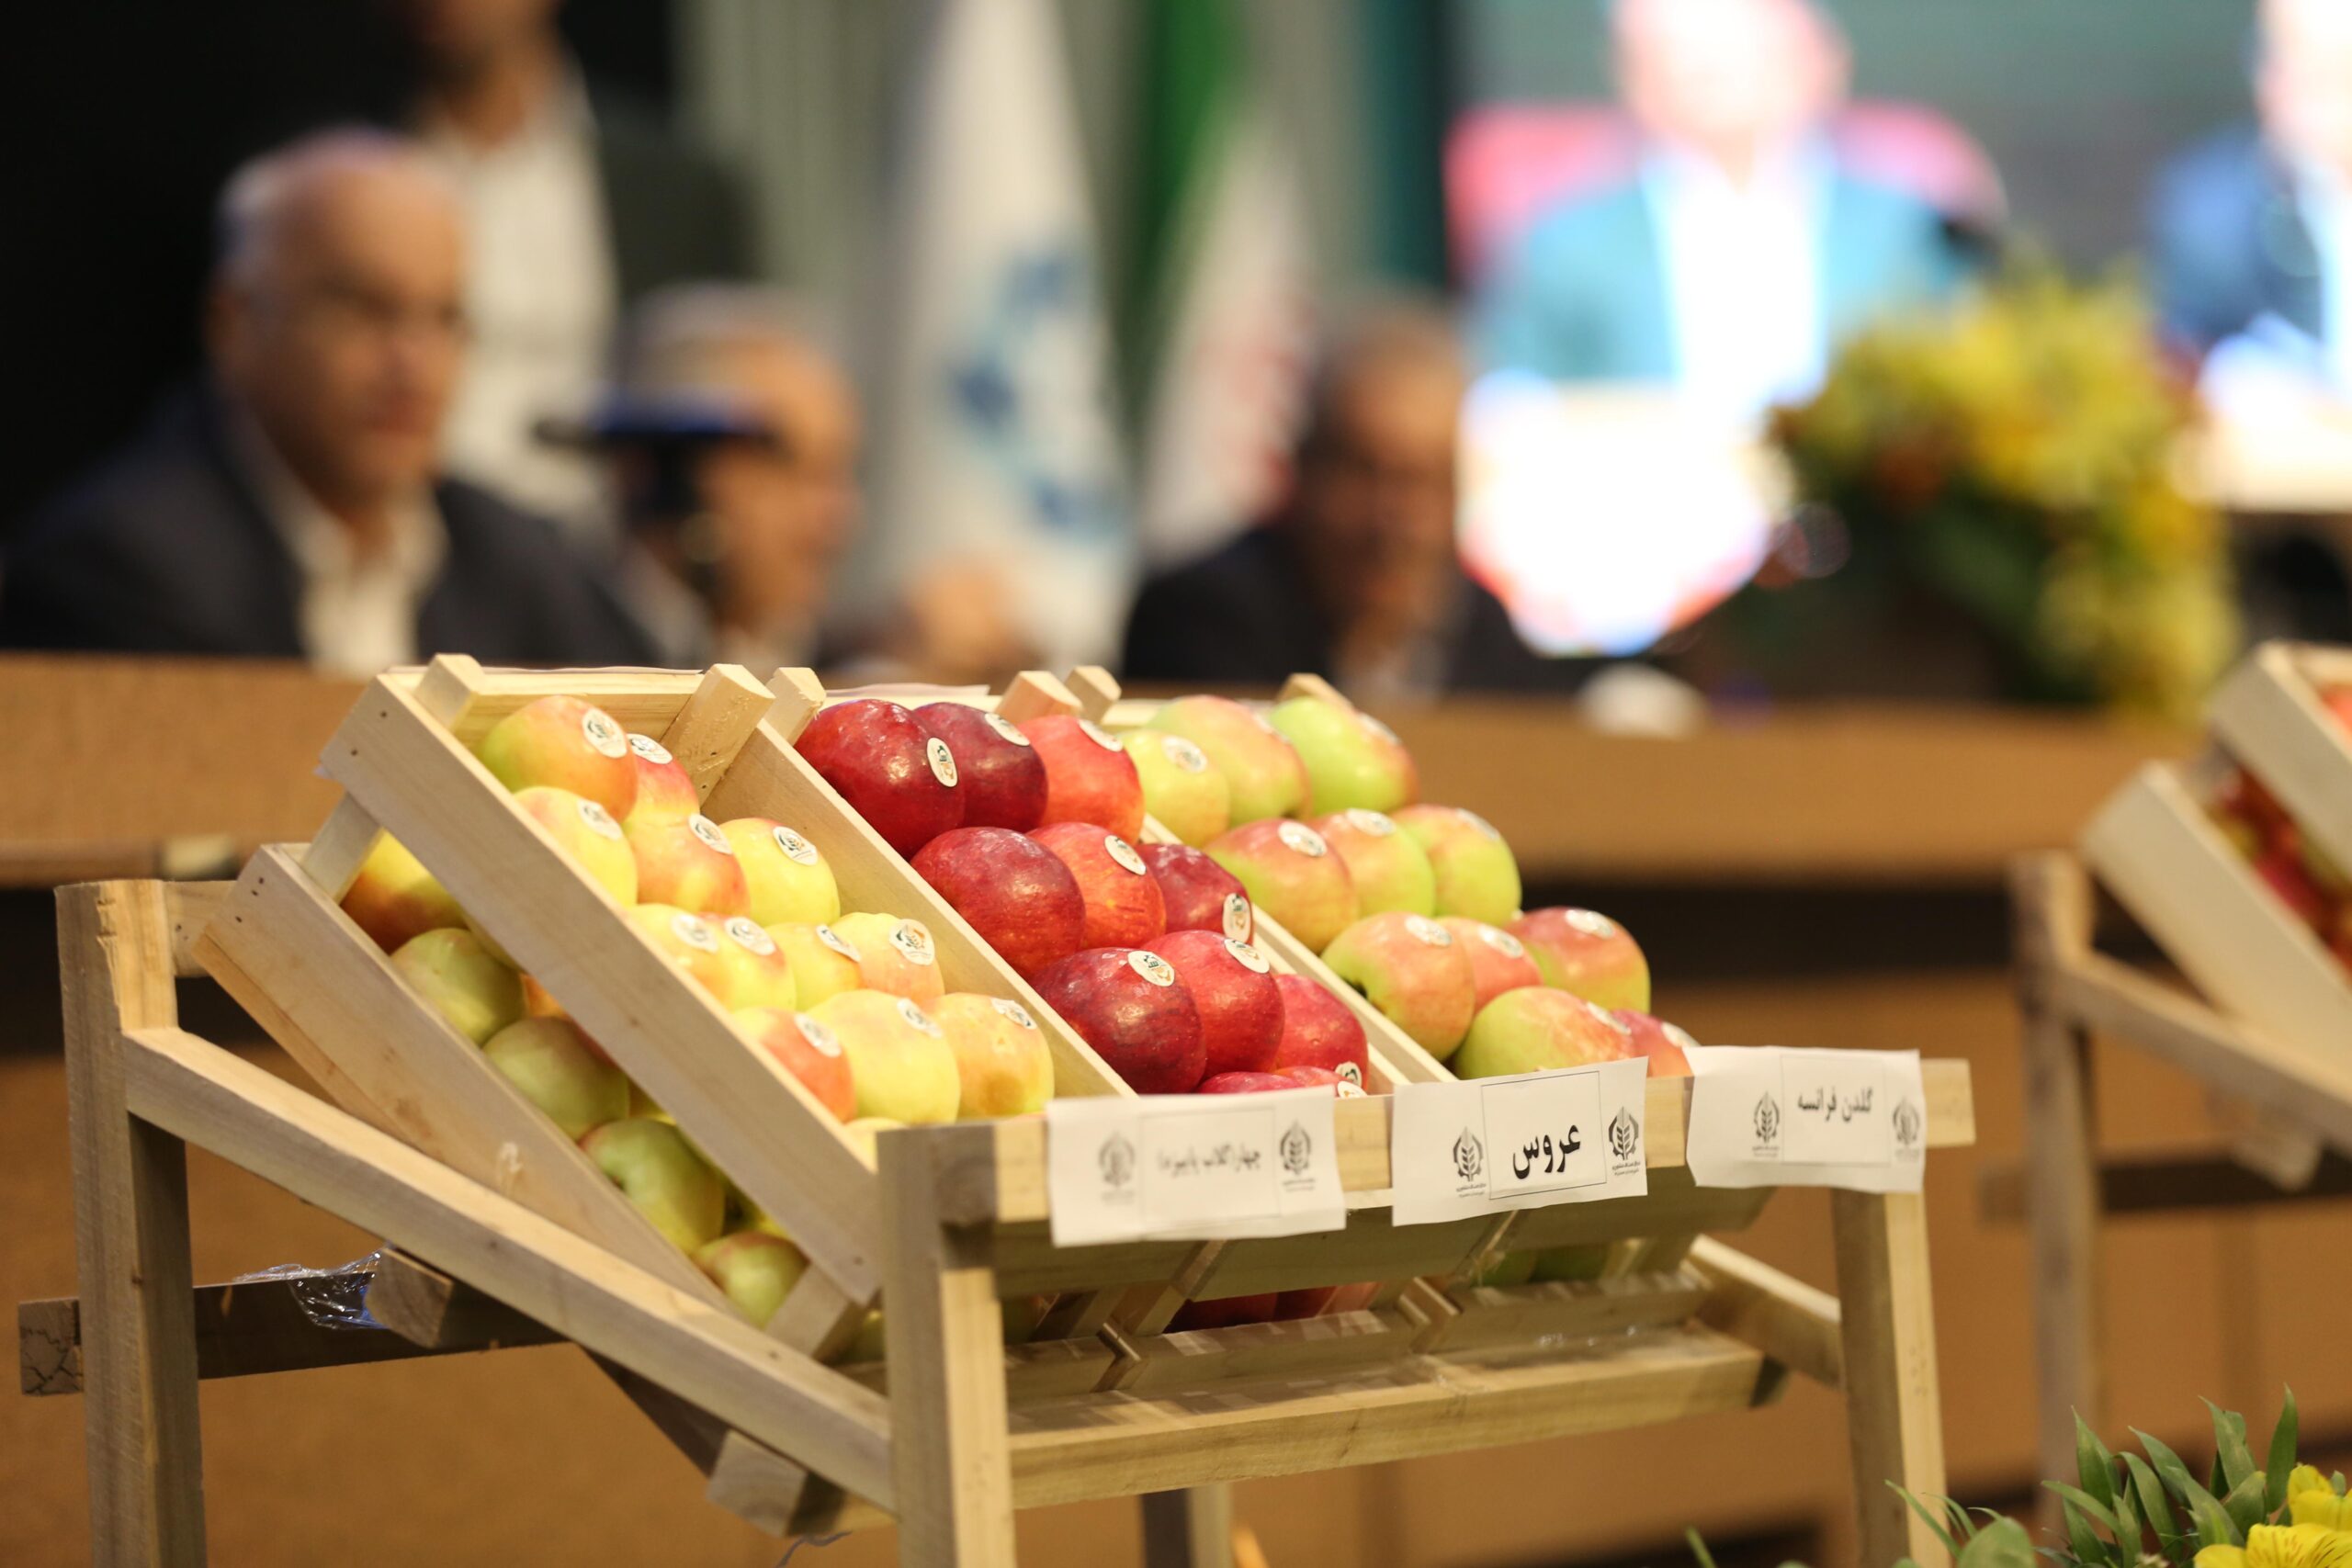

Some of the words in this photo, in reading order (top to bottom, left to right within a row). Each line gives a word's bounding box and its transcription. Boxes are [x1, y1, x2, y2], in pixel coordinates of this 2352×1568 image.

[1797, 1085, 1837, 1122] فرانسه
[1840, 1086, 1872, 1122] گلدن
[1512, 1124, 1581, 1179] عروس
